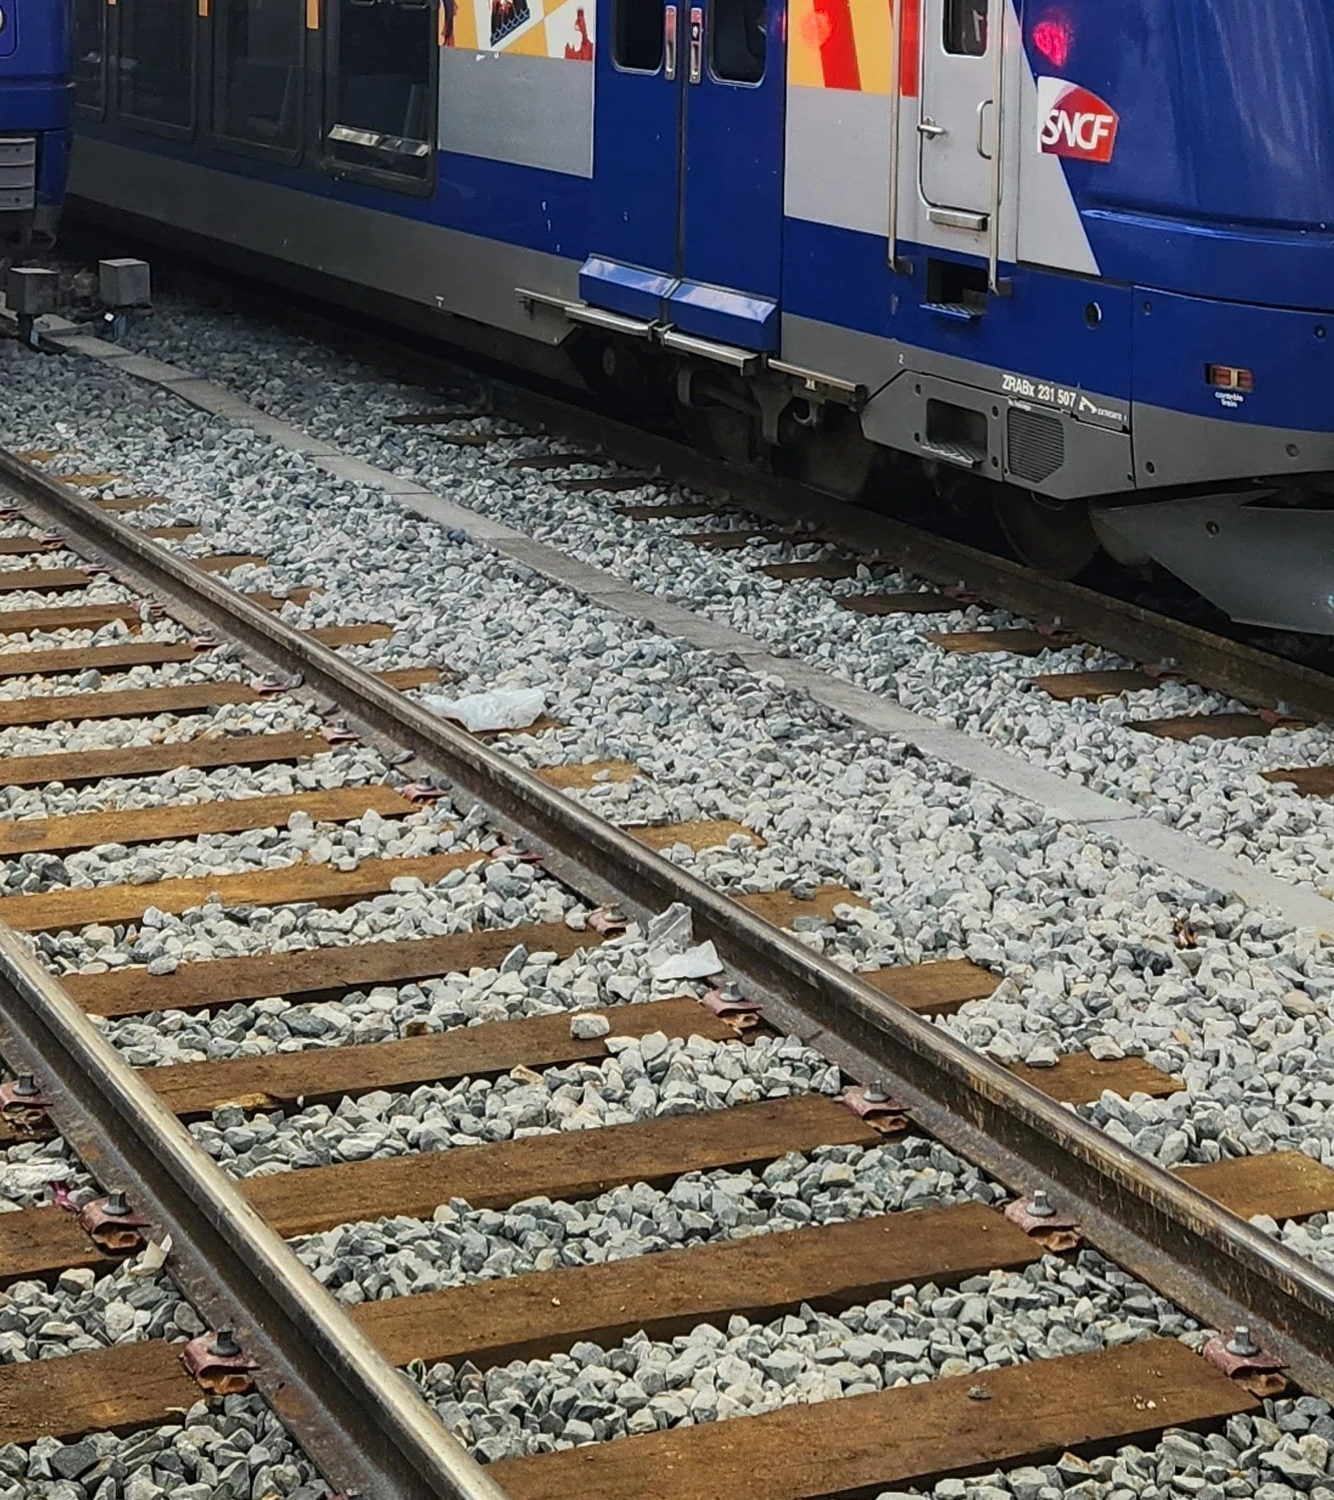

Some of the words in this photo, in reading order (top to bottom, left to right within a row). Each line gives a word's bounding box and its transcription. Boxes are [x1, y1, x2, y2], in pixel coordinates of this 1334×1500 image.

[1041, 108, 1114, 150] SNCF
[1037, 384, 1055, 402] 231
[1057, 390, 1077, 408] 507
